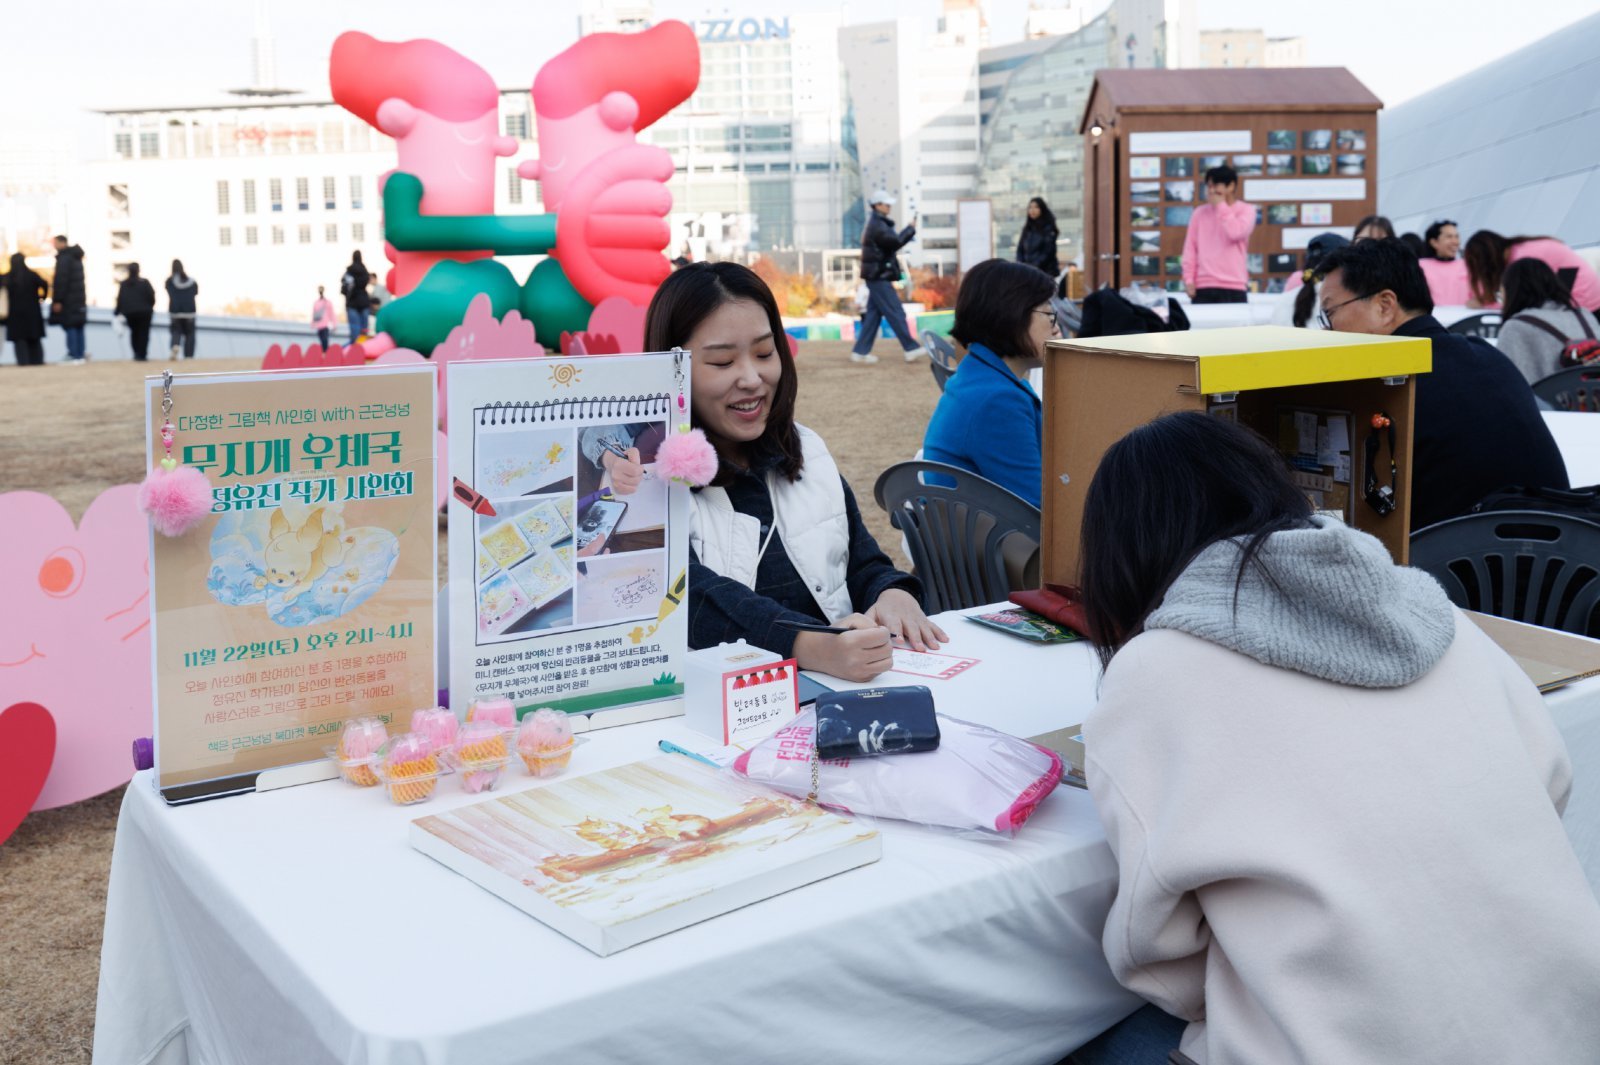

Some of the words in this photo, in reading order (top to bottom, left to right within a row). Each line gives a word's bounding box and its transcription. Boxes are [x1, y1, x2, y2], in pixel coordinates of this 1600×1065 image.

[178, 414, 224, 431] 다정한
[227, 411, 271, 428] 그림책
[275, 408, 317, 425] 사인회
[321, 406, 355, 422] with
[359, 402, 410, 420] 근근넝넝
[182, 438, 291, 478] 무지개
[300, 431, 403, 470] 우체국
[288, 478, 337, 504] 작가
[343, 471, 413, 500] 사인회
[184, 648, 217, 667] 11월
[223, 637, 299, 662] 22일(토)
[306, 631, 341, 651] 오후
[345, 622, 413, 646] 2시~4시
[475, 657, 491, 667] 오늘
[492, 652, 523, 664] 사인회에
[524, 648, 554, 660] 참여하신
[556, 646, 564, 655] 분
[565, 645, 573, 654] 중
[574, 642, 592, 652] 1명을
[593, 637, 622, 649] 추첨하여
[184, 680, 208, 694] 오늘
[211, 672, 257, 689] 사인회에
[260, 665, 305, 682] 참여하신
[309, 663, 319, 675] 분
[322, 660, 332, 673] 중
[337, 656, 362, 670] 1명을
[367, 650, 407, 666] 추첨하여
[475, 670, 491, 679] 미니
[492, 667, 515, 678] 캔버스
[517, 662, 540, 673] 액자에
[541, 659, 563, 670] 당신의
[565, 653, 601, 667] 반려동물을
[602, 650, 617, 660] 그려
[539, 671, 562, 682] 사인을
[563, 669, 578, 679] 받은
[580, 667, 588, 676] 후
[589, 662, 618, 675] 응모함에
[619, 659, 641, 670] 성함과
[641, 654, 669, 667] 연락처를
[212, 691, 246, 706] 정유진
[249, 683, 295, 699] 작가님이
[298, 678, 331, 693] 당신의
[334, 669, 386, 689] 반려동물을
[517, 685, 554, 699] 넣어주시면
[555, 682, 571, 693] 참여
[572, 679, 589, 690] 완료!
[204, 705, 261, 725] 사랑스러운
[264, 698, 307, 716] 그림으로
[309, 694, 331, 708] 그려
[335, 690, 356, 705] 드릴
[207, 740, 229, 752] 책은
[275, 726, 305, 741] 북마켓
